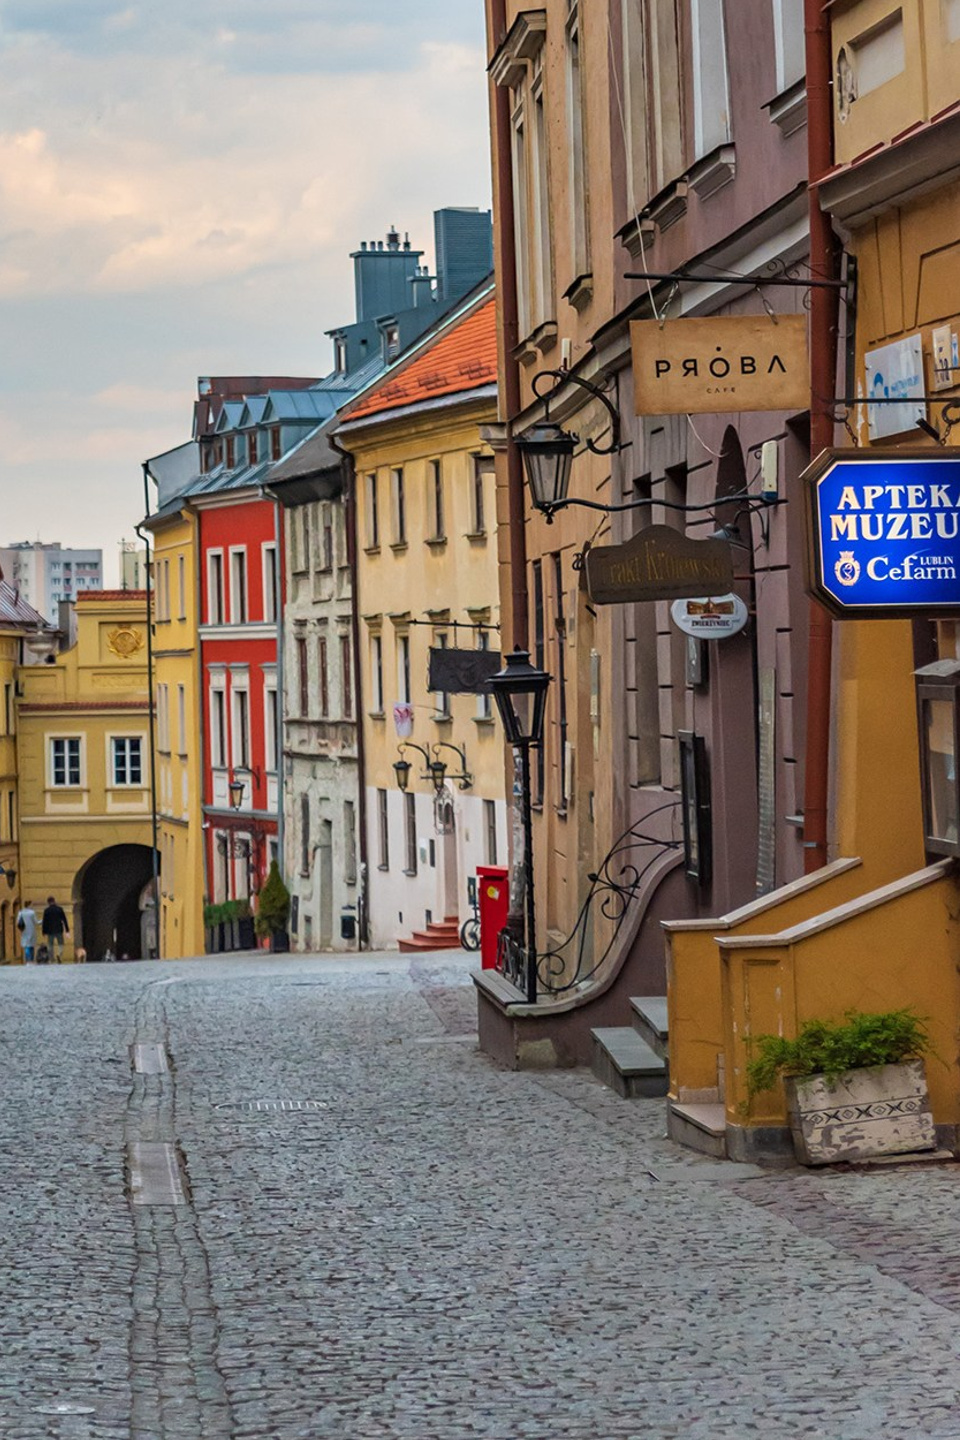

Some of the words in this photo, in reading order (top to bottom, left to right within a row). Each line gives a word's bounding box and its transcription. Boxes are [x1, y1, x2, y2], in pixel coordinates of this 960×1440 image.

[706, 386, 736, 394] CAFE
[837, 484, 960, 510] APTEK
[829, 512, 959, 541] MUZEU
[866, 554, 957, 581] Cefarm
[920, 556, 954, 565] LUBLIN
